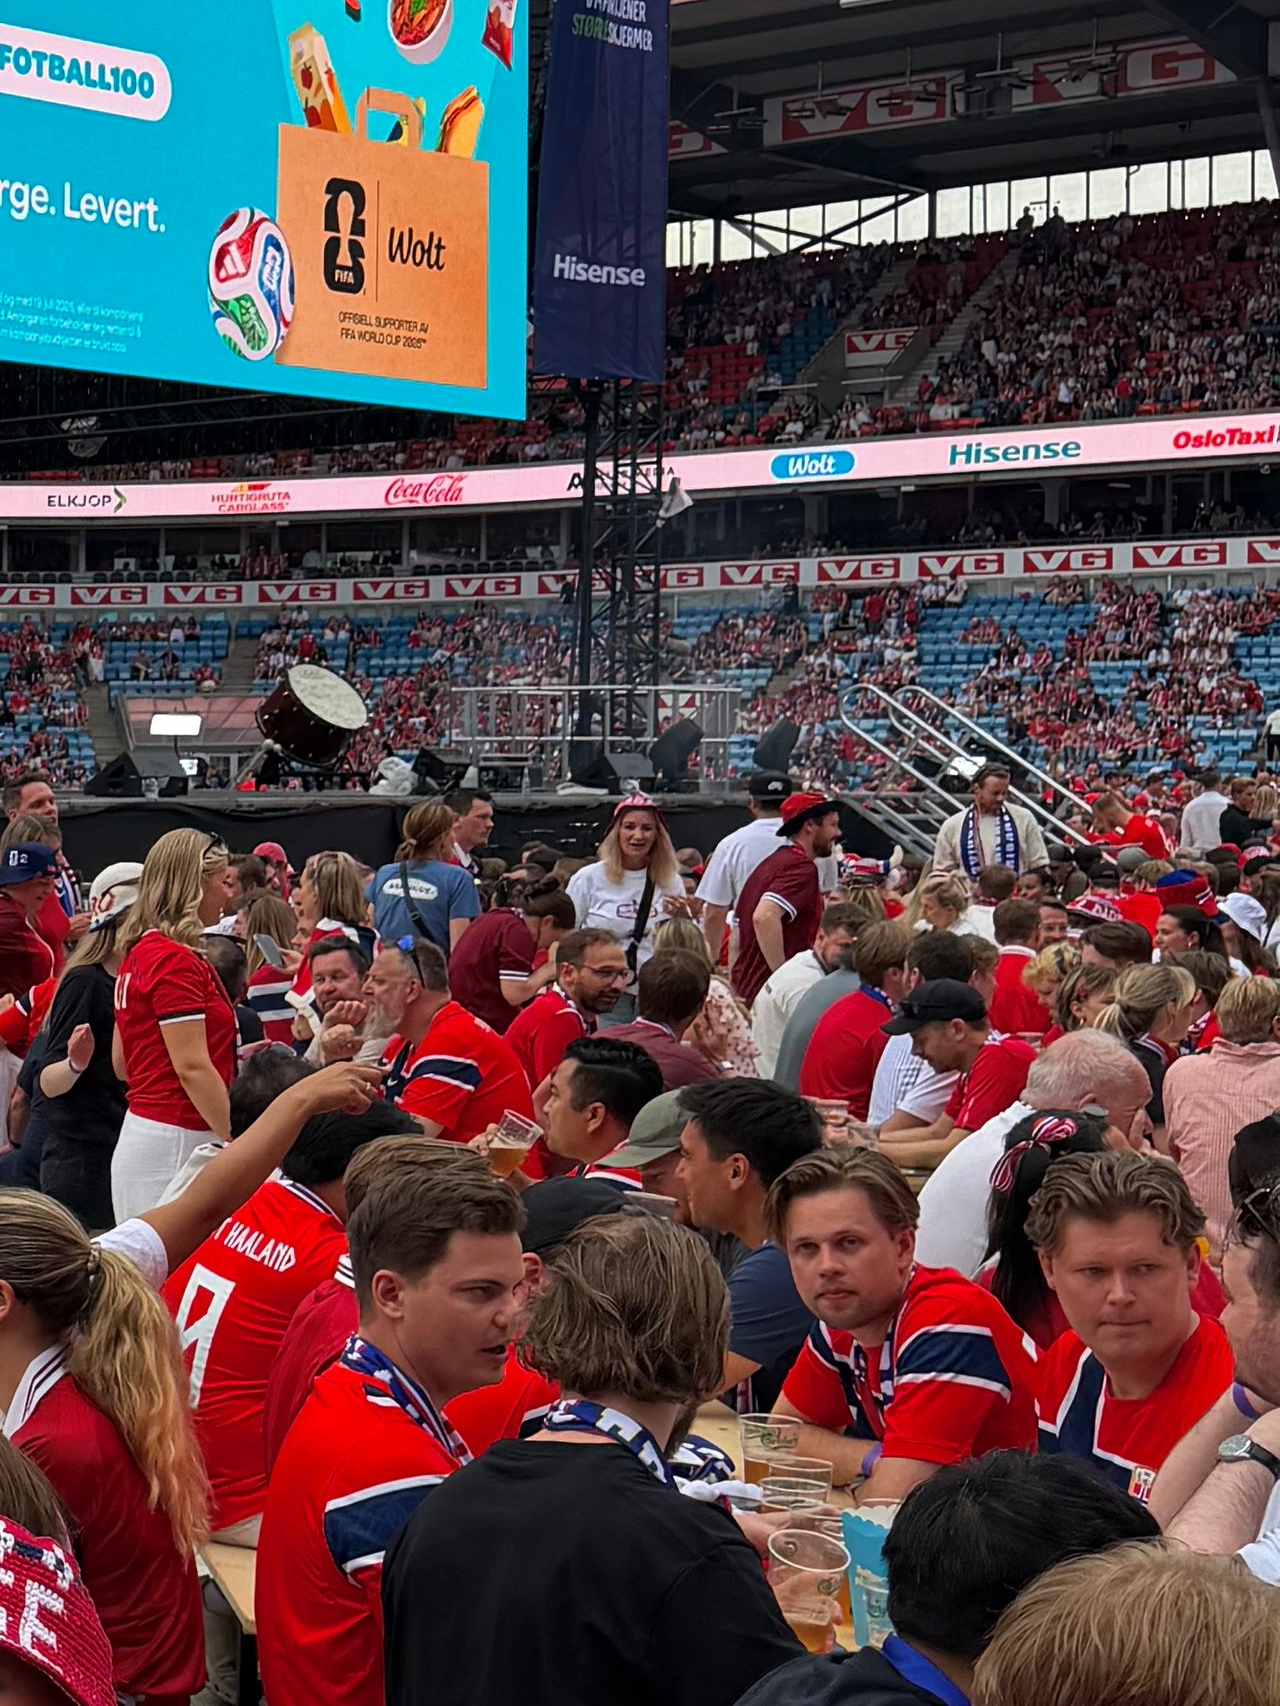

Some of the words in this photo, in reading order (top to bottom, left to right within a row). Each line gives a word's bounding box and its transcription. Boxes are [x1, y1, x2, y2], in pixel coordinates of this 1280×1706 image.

[63, 185, 166, 235] Levert.
[388, 225, 446, 272] Wolt
[334, 269, 354, 284] FIFA
[553, 253, 646, 287] Hisense
[357, 329, 384, 345] WORLD
[1173, 426, 1275, 450] OsloTaxi
[950, 440, 1081, 466] Hisense
[788, 453, 837, 477] Wolt
[211, 492, 291, 503] HURTIGRUTA
[384, 474, 468, 505] Coca-Cola
[920, 554, 1002, 575] VG
[1025, 548, 1113, 570] VG
[1134, 543, 1227, 565] VG
[723, 563, 797, 584] VG
[819, 559, 899, 579] VG
[74, 586, 146, 603] VG
[166, 586, 241, 603] VG
[262, 584, 335, 601] VG
[355, 581, 429, 598] VG
[447, 577, 520, 594] VG
[223, 1219, 297, 1273] HAALAND
